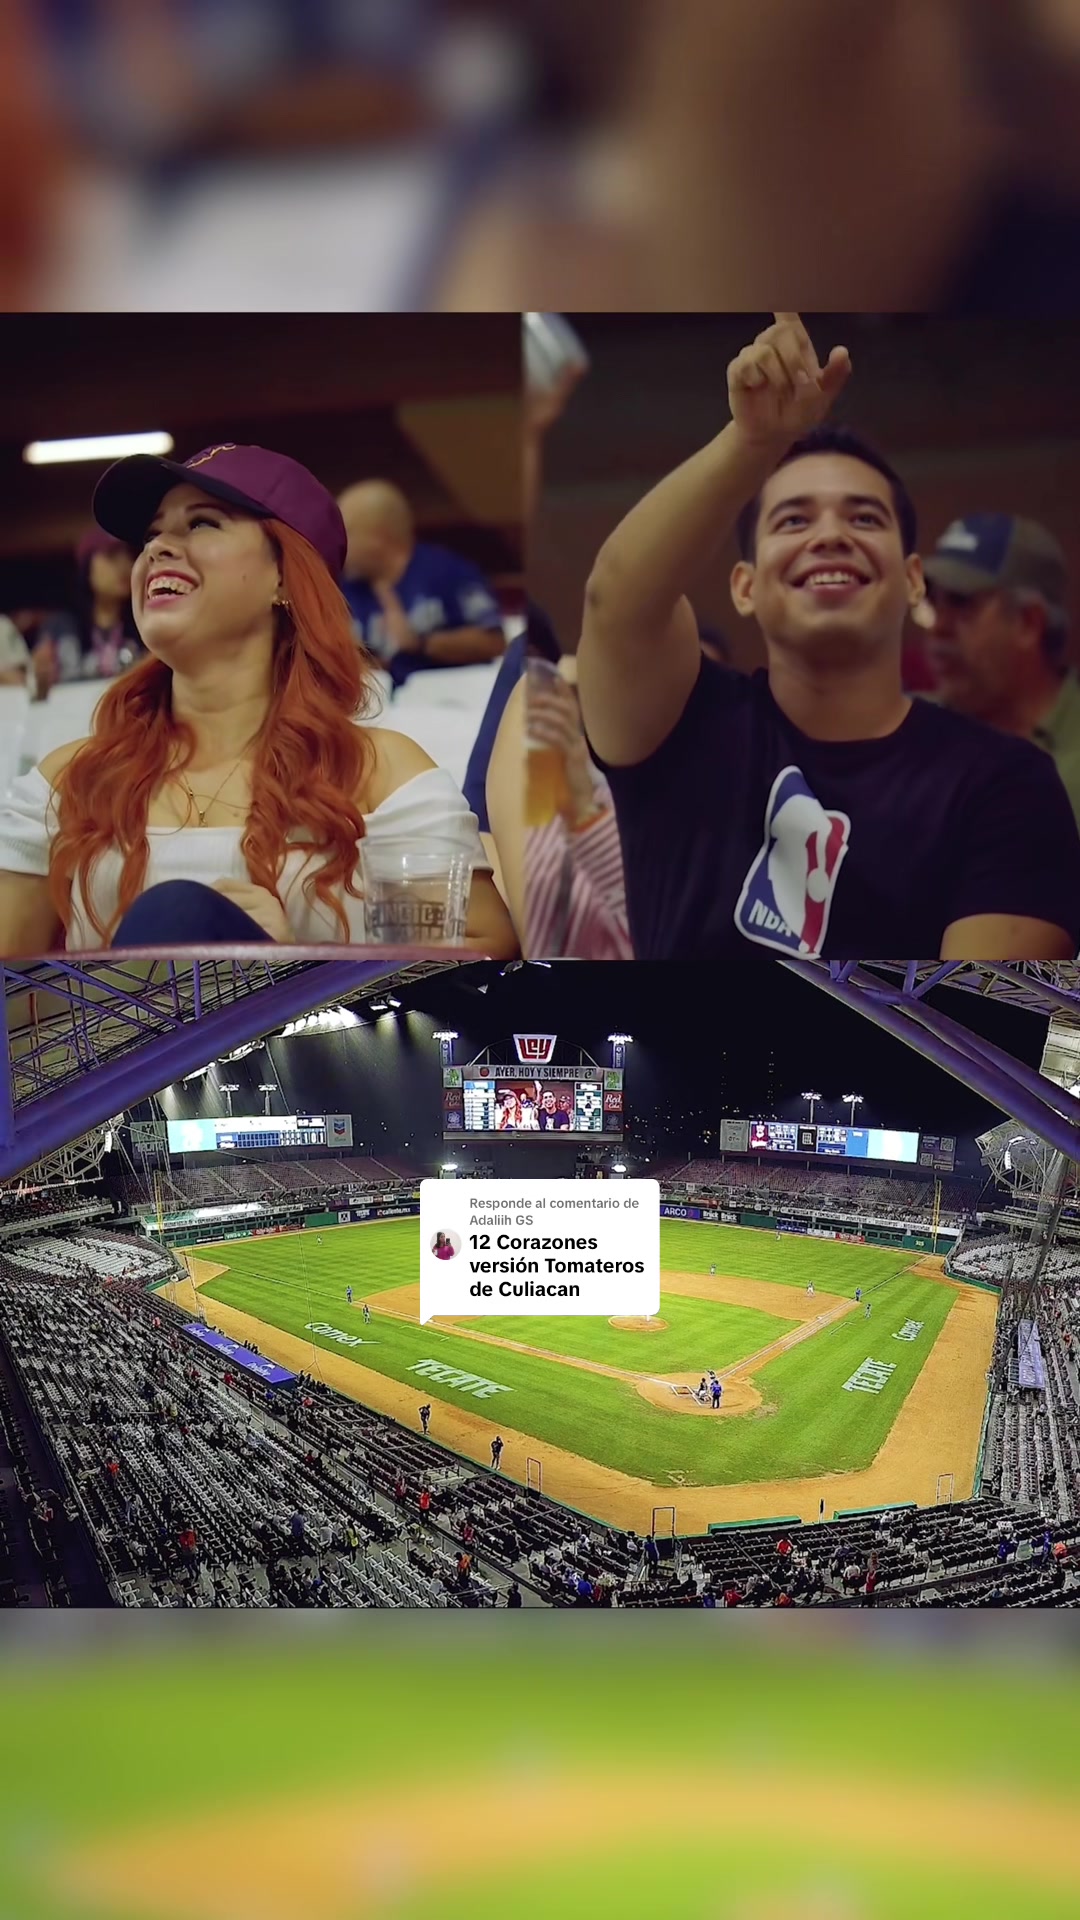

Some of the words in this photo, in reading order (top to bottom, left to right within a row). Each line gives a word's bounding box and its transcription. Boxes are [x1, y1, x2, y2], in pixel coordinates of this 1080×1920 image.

[495, 1067, 517, 1078] AYER,
[519, 1067, 535, 1077] HOY
[536, 1067, 543, 1077] Y
[543, 1067, 579, 1077] SIEMPRE
[664, 1208, 687, 1217] ARCO
[405, 1358, 516, 1399] TECATE
[841, 1356, 897, 1395] TECATE
